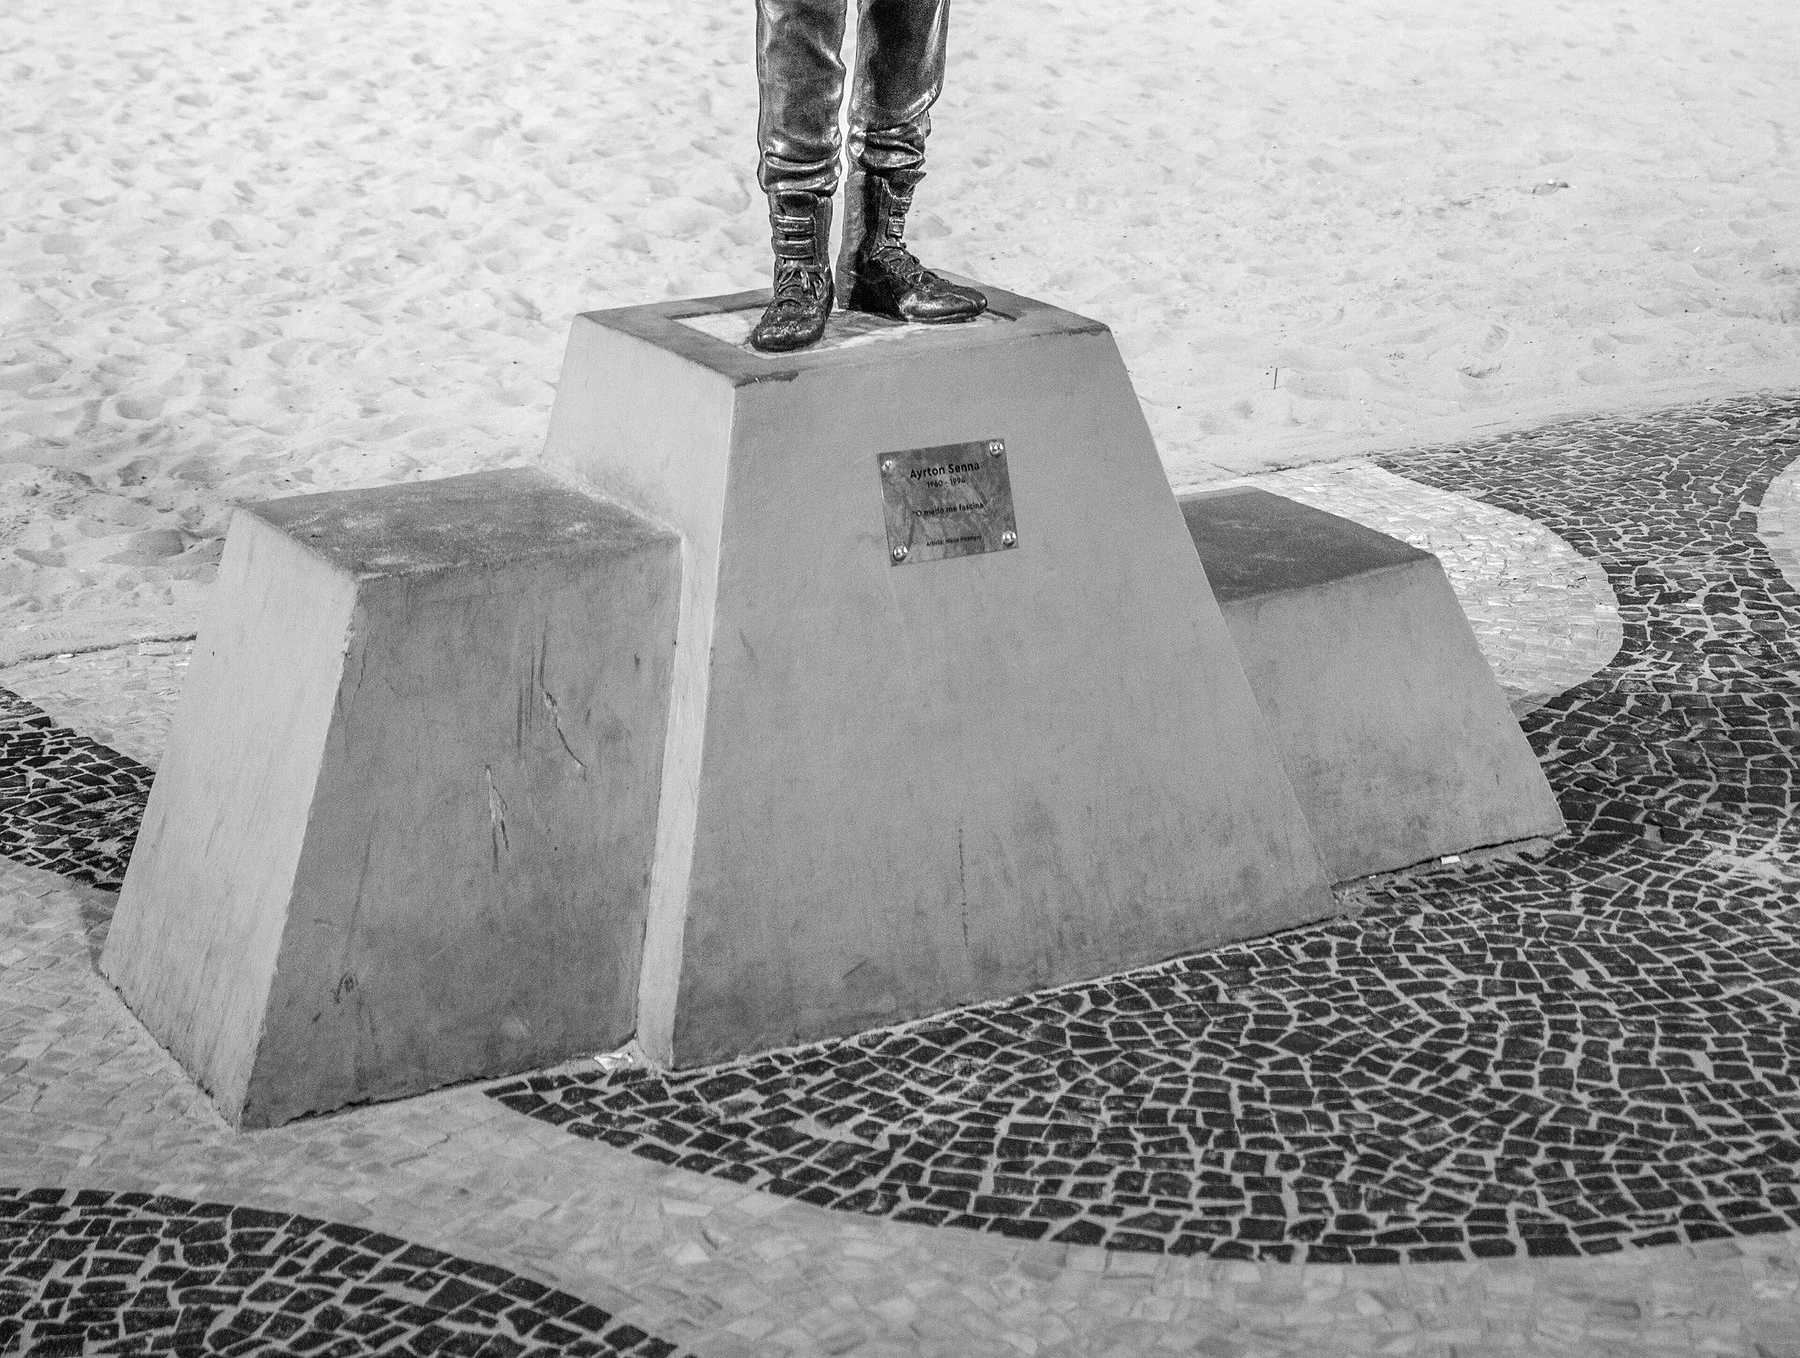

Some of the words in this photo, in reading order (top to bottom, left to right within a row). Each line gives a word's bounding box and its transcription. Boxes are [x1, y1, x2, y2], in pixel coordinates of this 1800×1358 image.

[910, 467, 945, 480] Ayrton
[948, 462, 980, 474] Senna
[926, 480, 943, 489] 1960
[923, 506, 945, 516] medo
